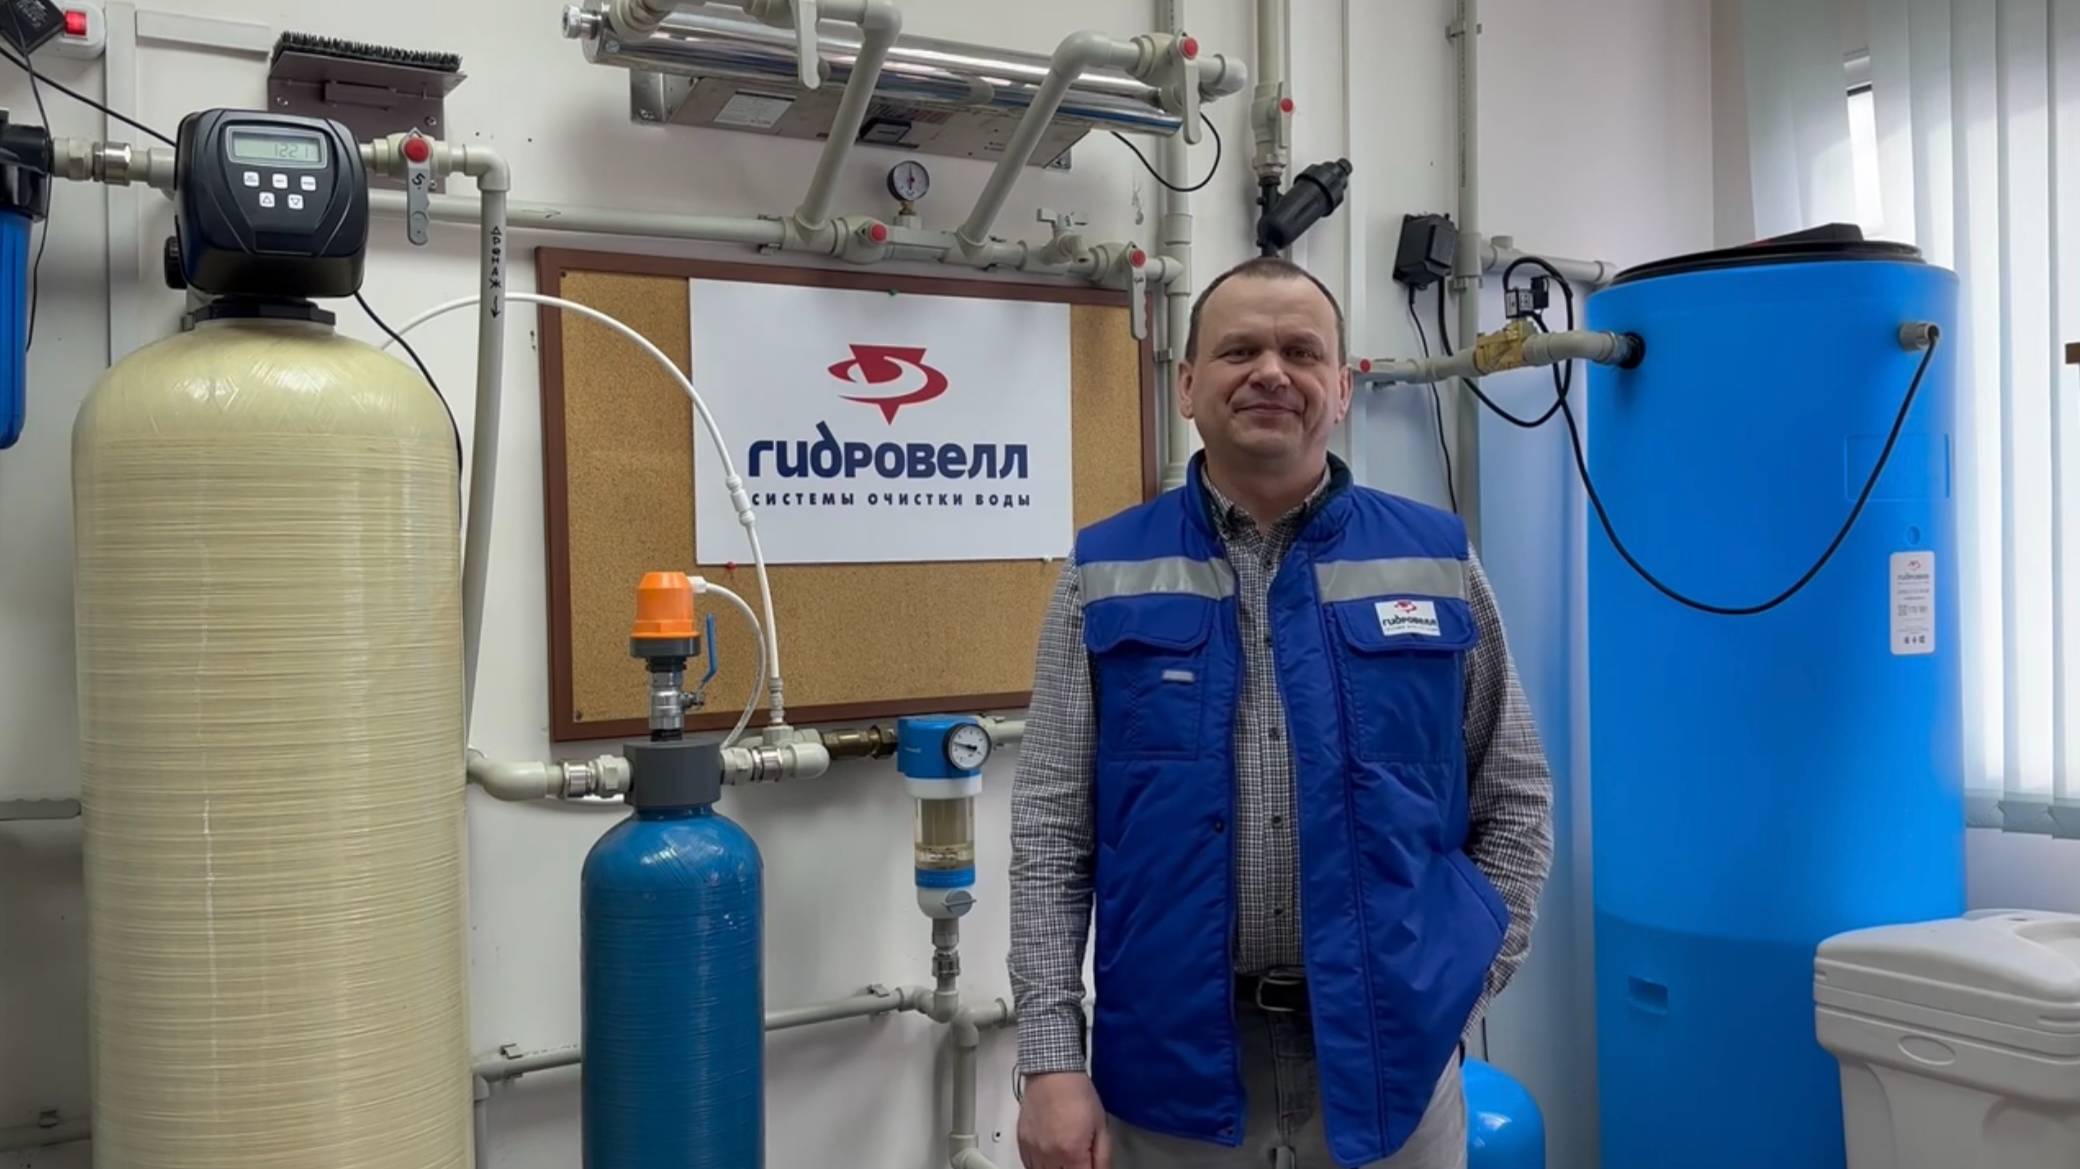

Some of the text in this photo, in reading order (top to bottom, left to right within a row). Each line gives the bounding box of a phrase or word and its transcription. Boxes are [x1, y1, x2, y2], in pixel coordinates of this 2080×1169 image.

[751, 492, 1030, 508] СИСТЕМЫ ОЧИСТКИ ВОДЫ
